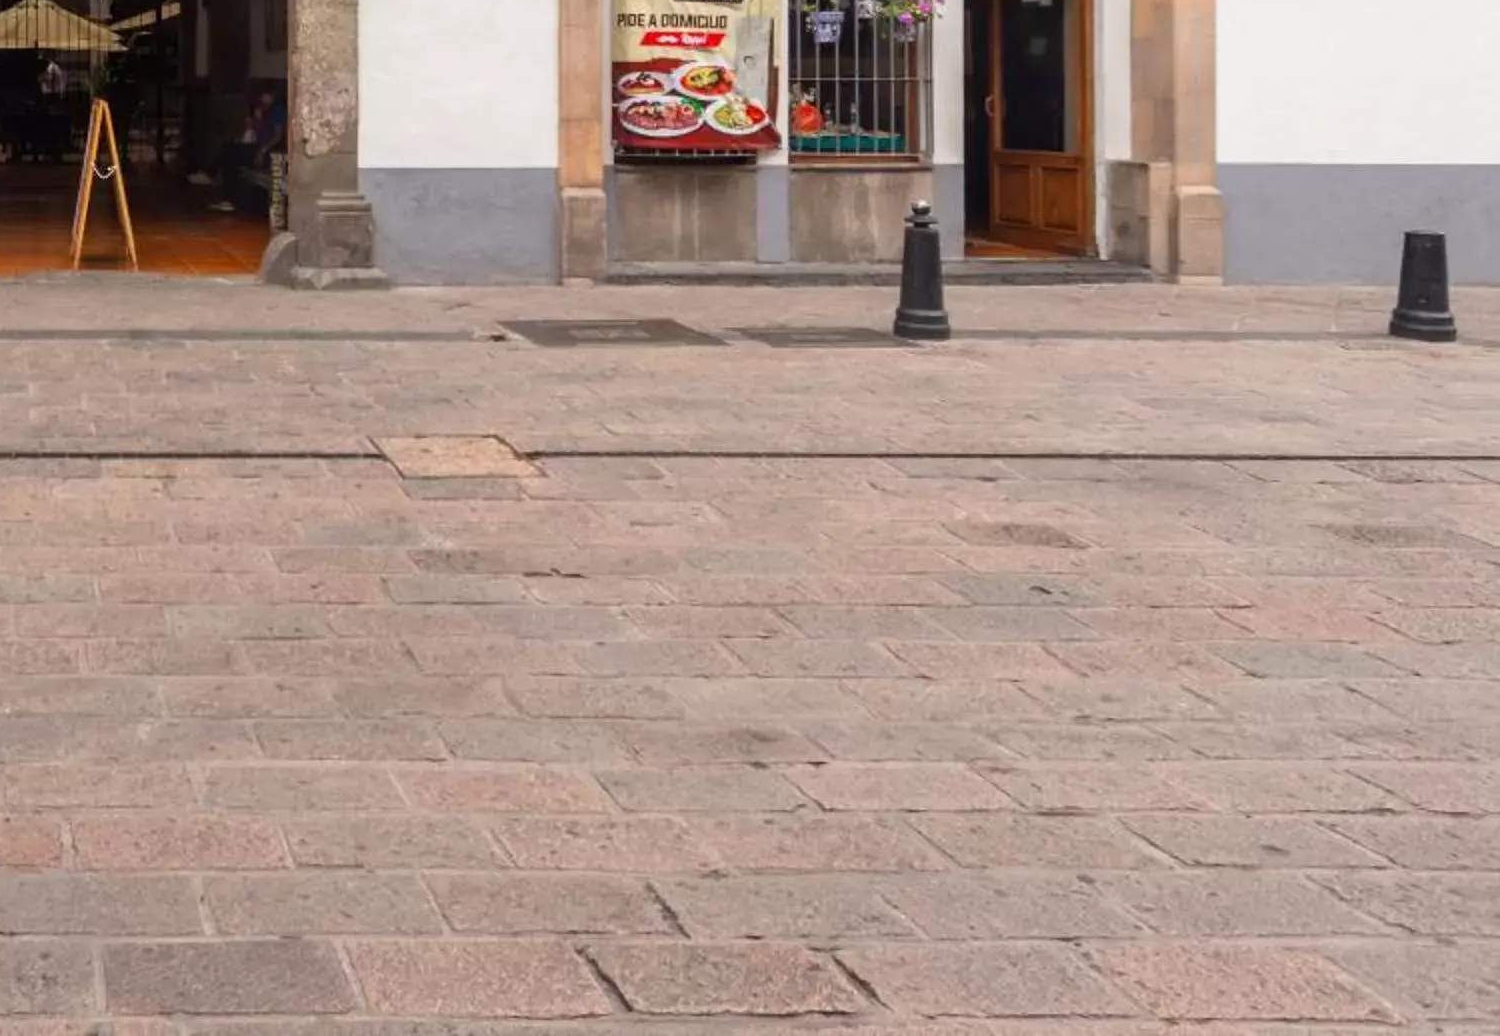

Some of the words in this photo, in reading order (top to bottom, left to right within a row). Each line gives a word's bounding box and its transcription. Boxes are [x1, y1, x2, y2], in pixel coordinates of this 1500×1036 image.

[616, 13, 645, 27] PIDE
[648, 13, 658, 27] A
[660, 13, 729, 29] DOMICILIO
